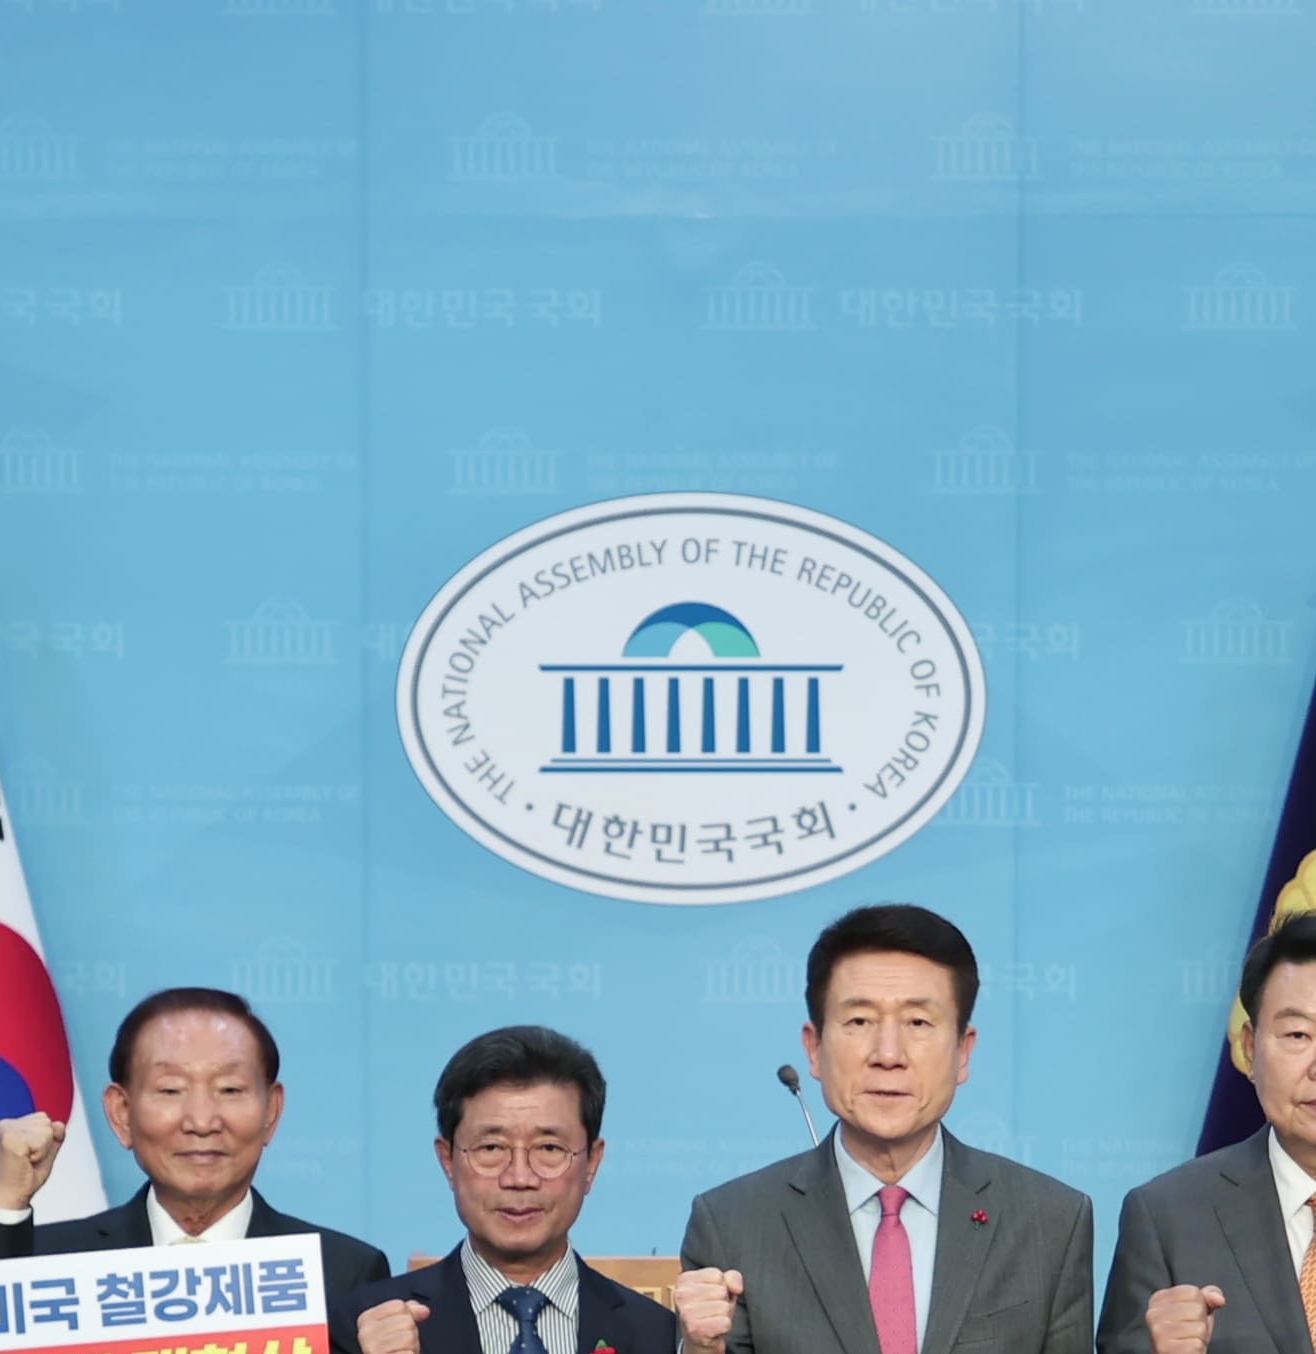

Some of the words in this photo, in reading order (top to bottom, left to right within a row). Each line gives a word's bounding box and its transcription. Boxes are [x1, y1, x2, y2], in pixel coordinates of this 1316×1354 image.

[518, 540, 668, 608] ASSEMBLY
[681, 538, 719, 563] OF
[732, 541, 788, 576] THE
[797, 557, 922, 654] REPUBLIC
[442, 603, 515, 747] NATIONAL
[910, 659, 941, 698] OF
[469, 751, 515, 805] THE
[863, 710, 939, 800] KOREA
[552, 801, 836, 864] 대한민국국회
[95, 1258, 309, 1328] 철강제품
